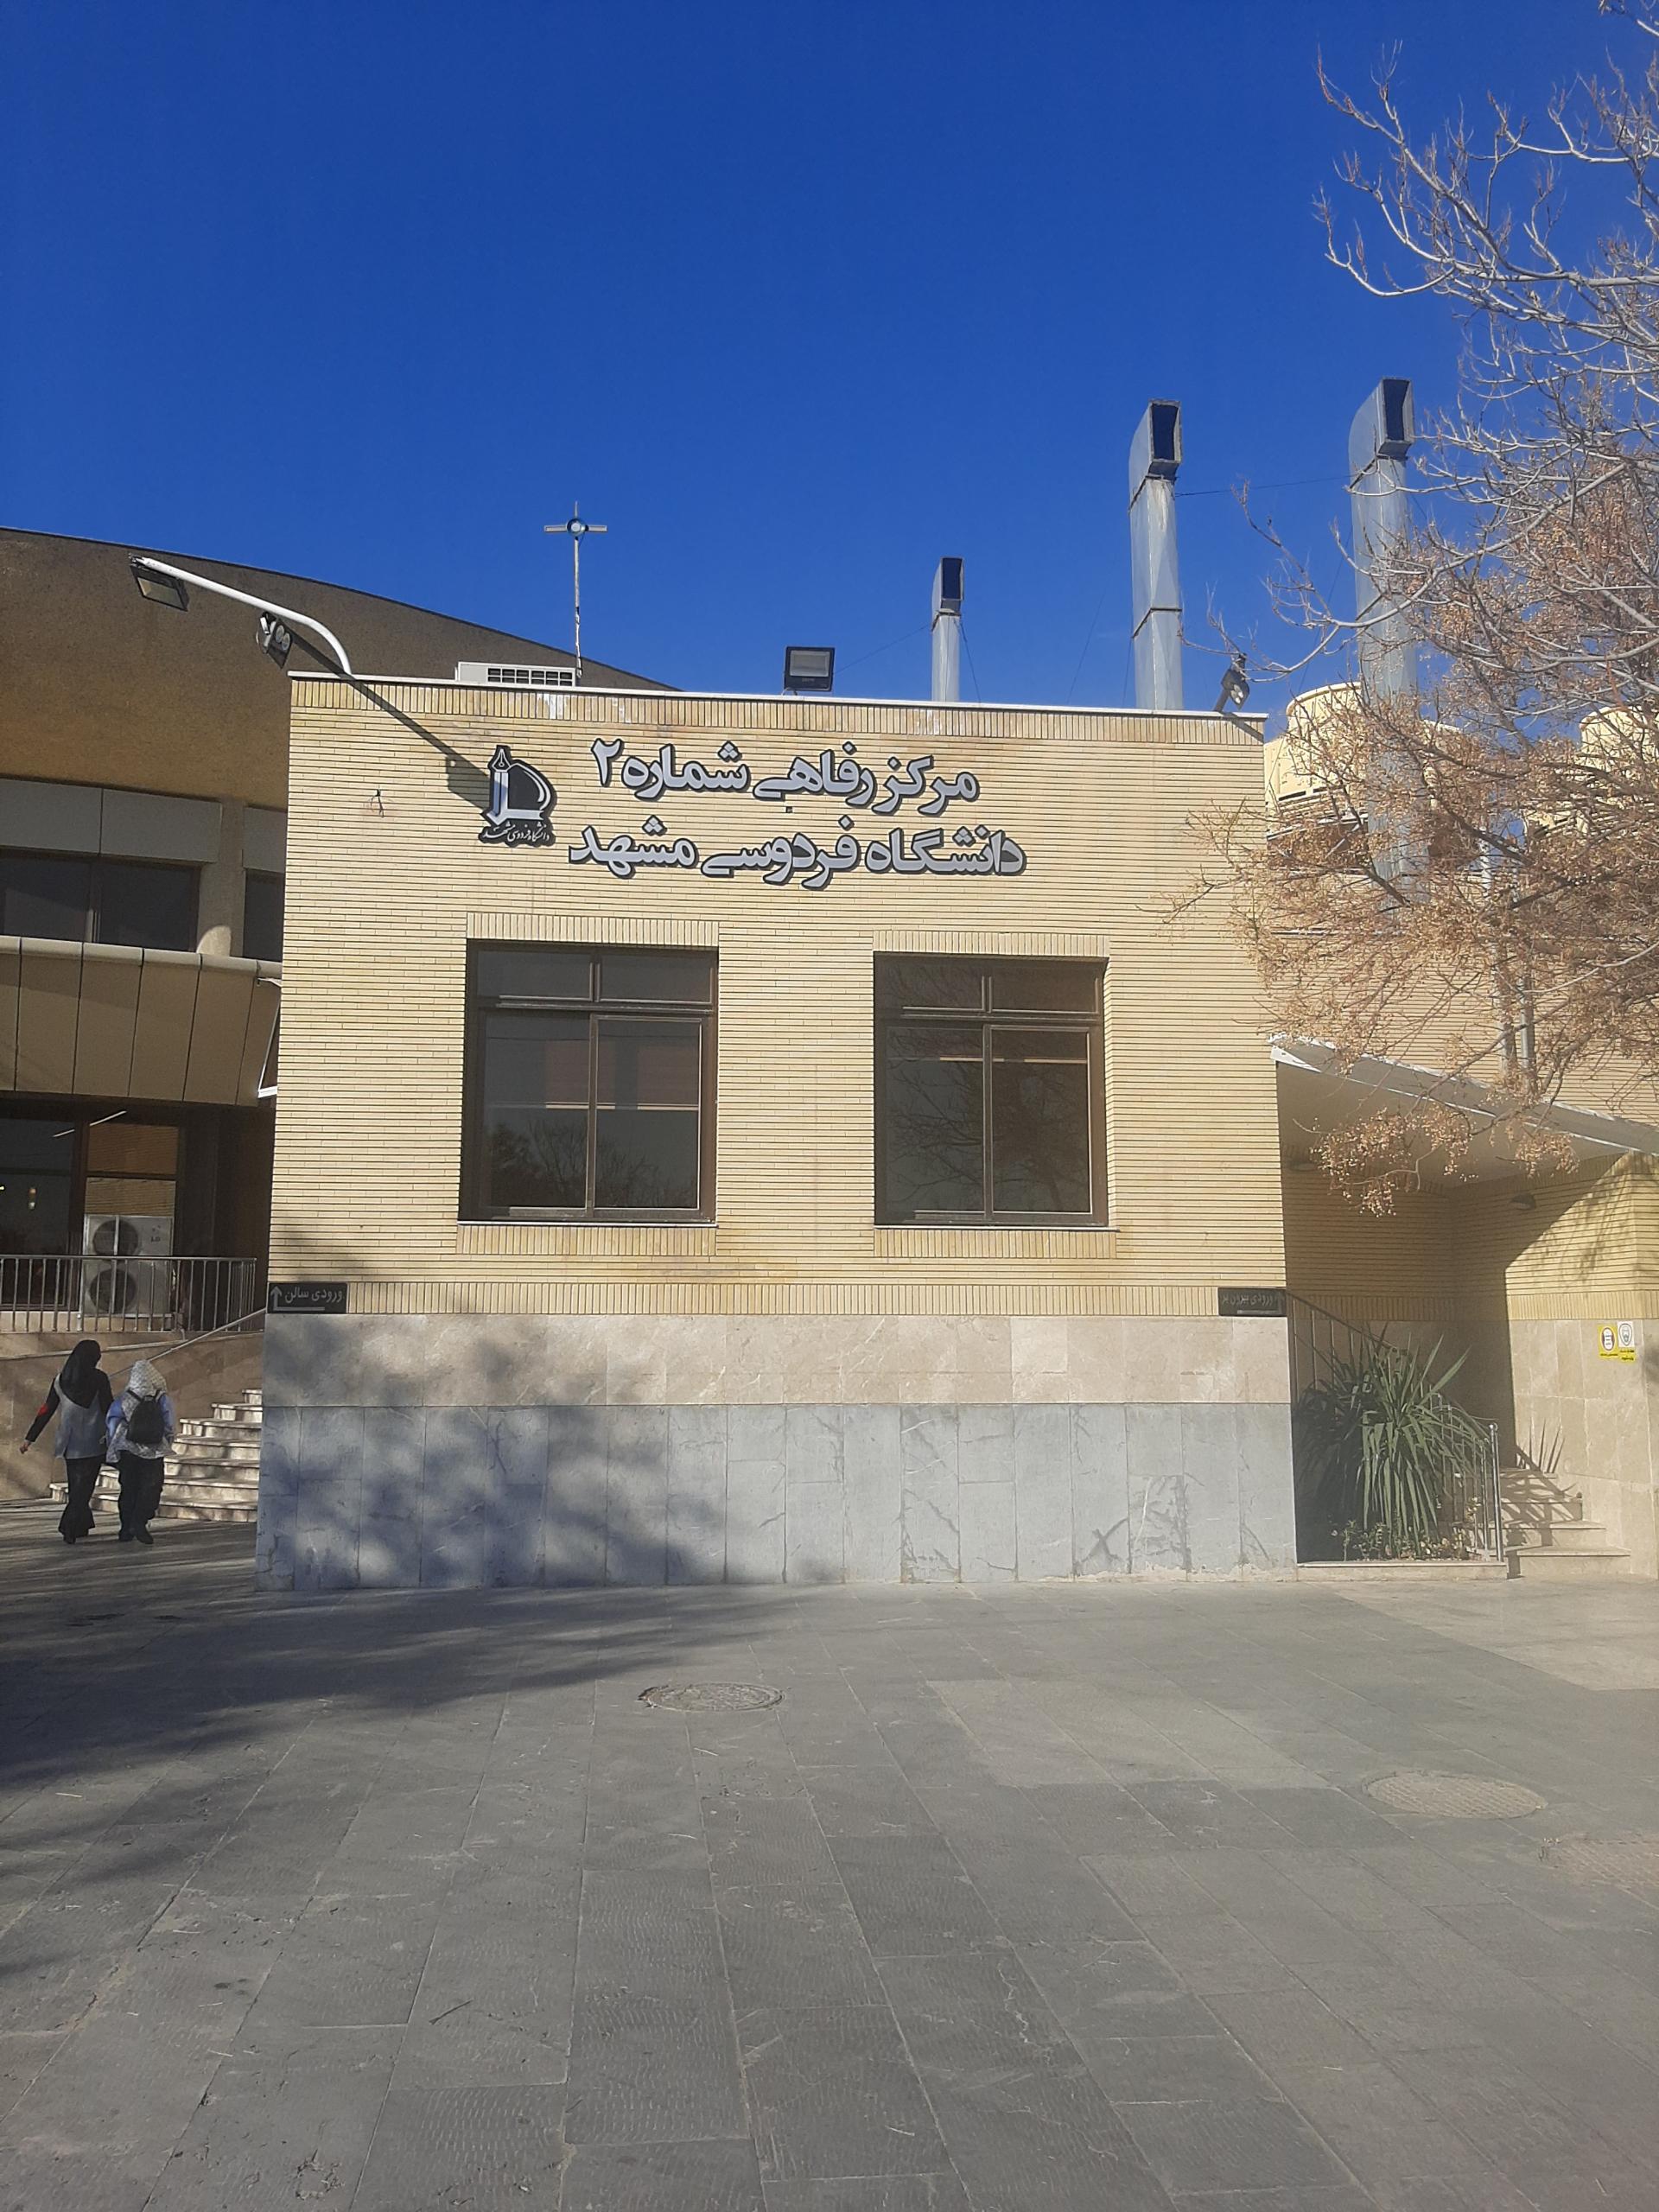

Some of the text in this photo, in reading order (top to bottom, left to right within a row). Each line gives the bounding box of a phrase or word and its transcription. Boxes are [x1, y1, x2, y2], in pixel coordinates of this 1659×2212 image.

[591, 738, 979, 816] مرکز رفاهی شماره ۲
[483, 821, 550, 842] دانشگاه فردوسی مشهد
[569, 814, 1026, 889] دانشگاه فردوسی مشهد
[285, 1286, 343, 1303] ورودی سالن
